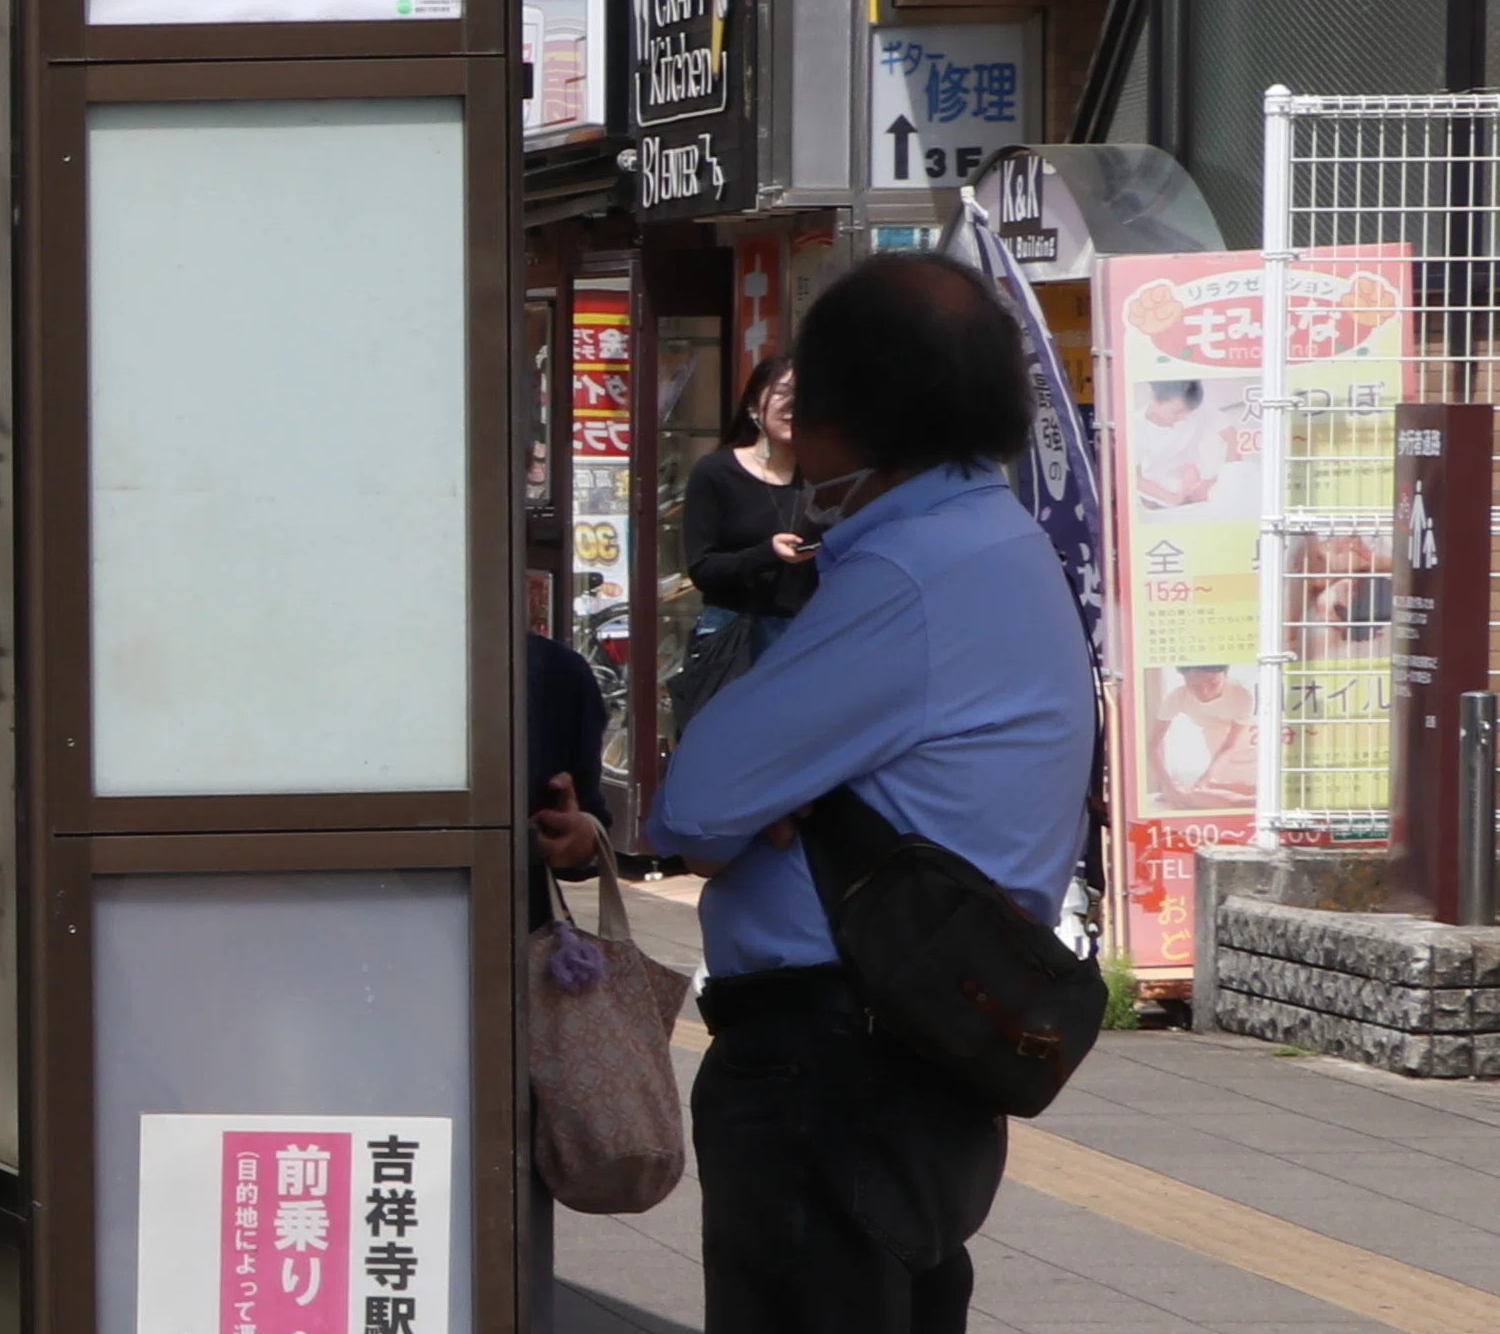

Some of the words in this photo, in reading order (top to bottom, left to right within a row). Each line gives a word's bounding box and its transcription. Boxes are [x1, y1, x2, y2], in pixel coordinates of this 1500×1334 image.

[650, 32, 713, 106] Kitchen
[881, 41, 945, 76] ギター
[925, 63, 1017, 124] 修理
[925, 146, 983, 179] 3F
[1002, 155, 1040, 223] K&K
[1015, 236, 1056, 259] Building
[1188, 276, 1336, 301] リラクゼション
[1146, 858, 1192, 880] TEL
[1158, 896, 1188, 926] お
[1161, 931, 1191, 961] ど
